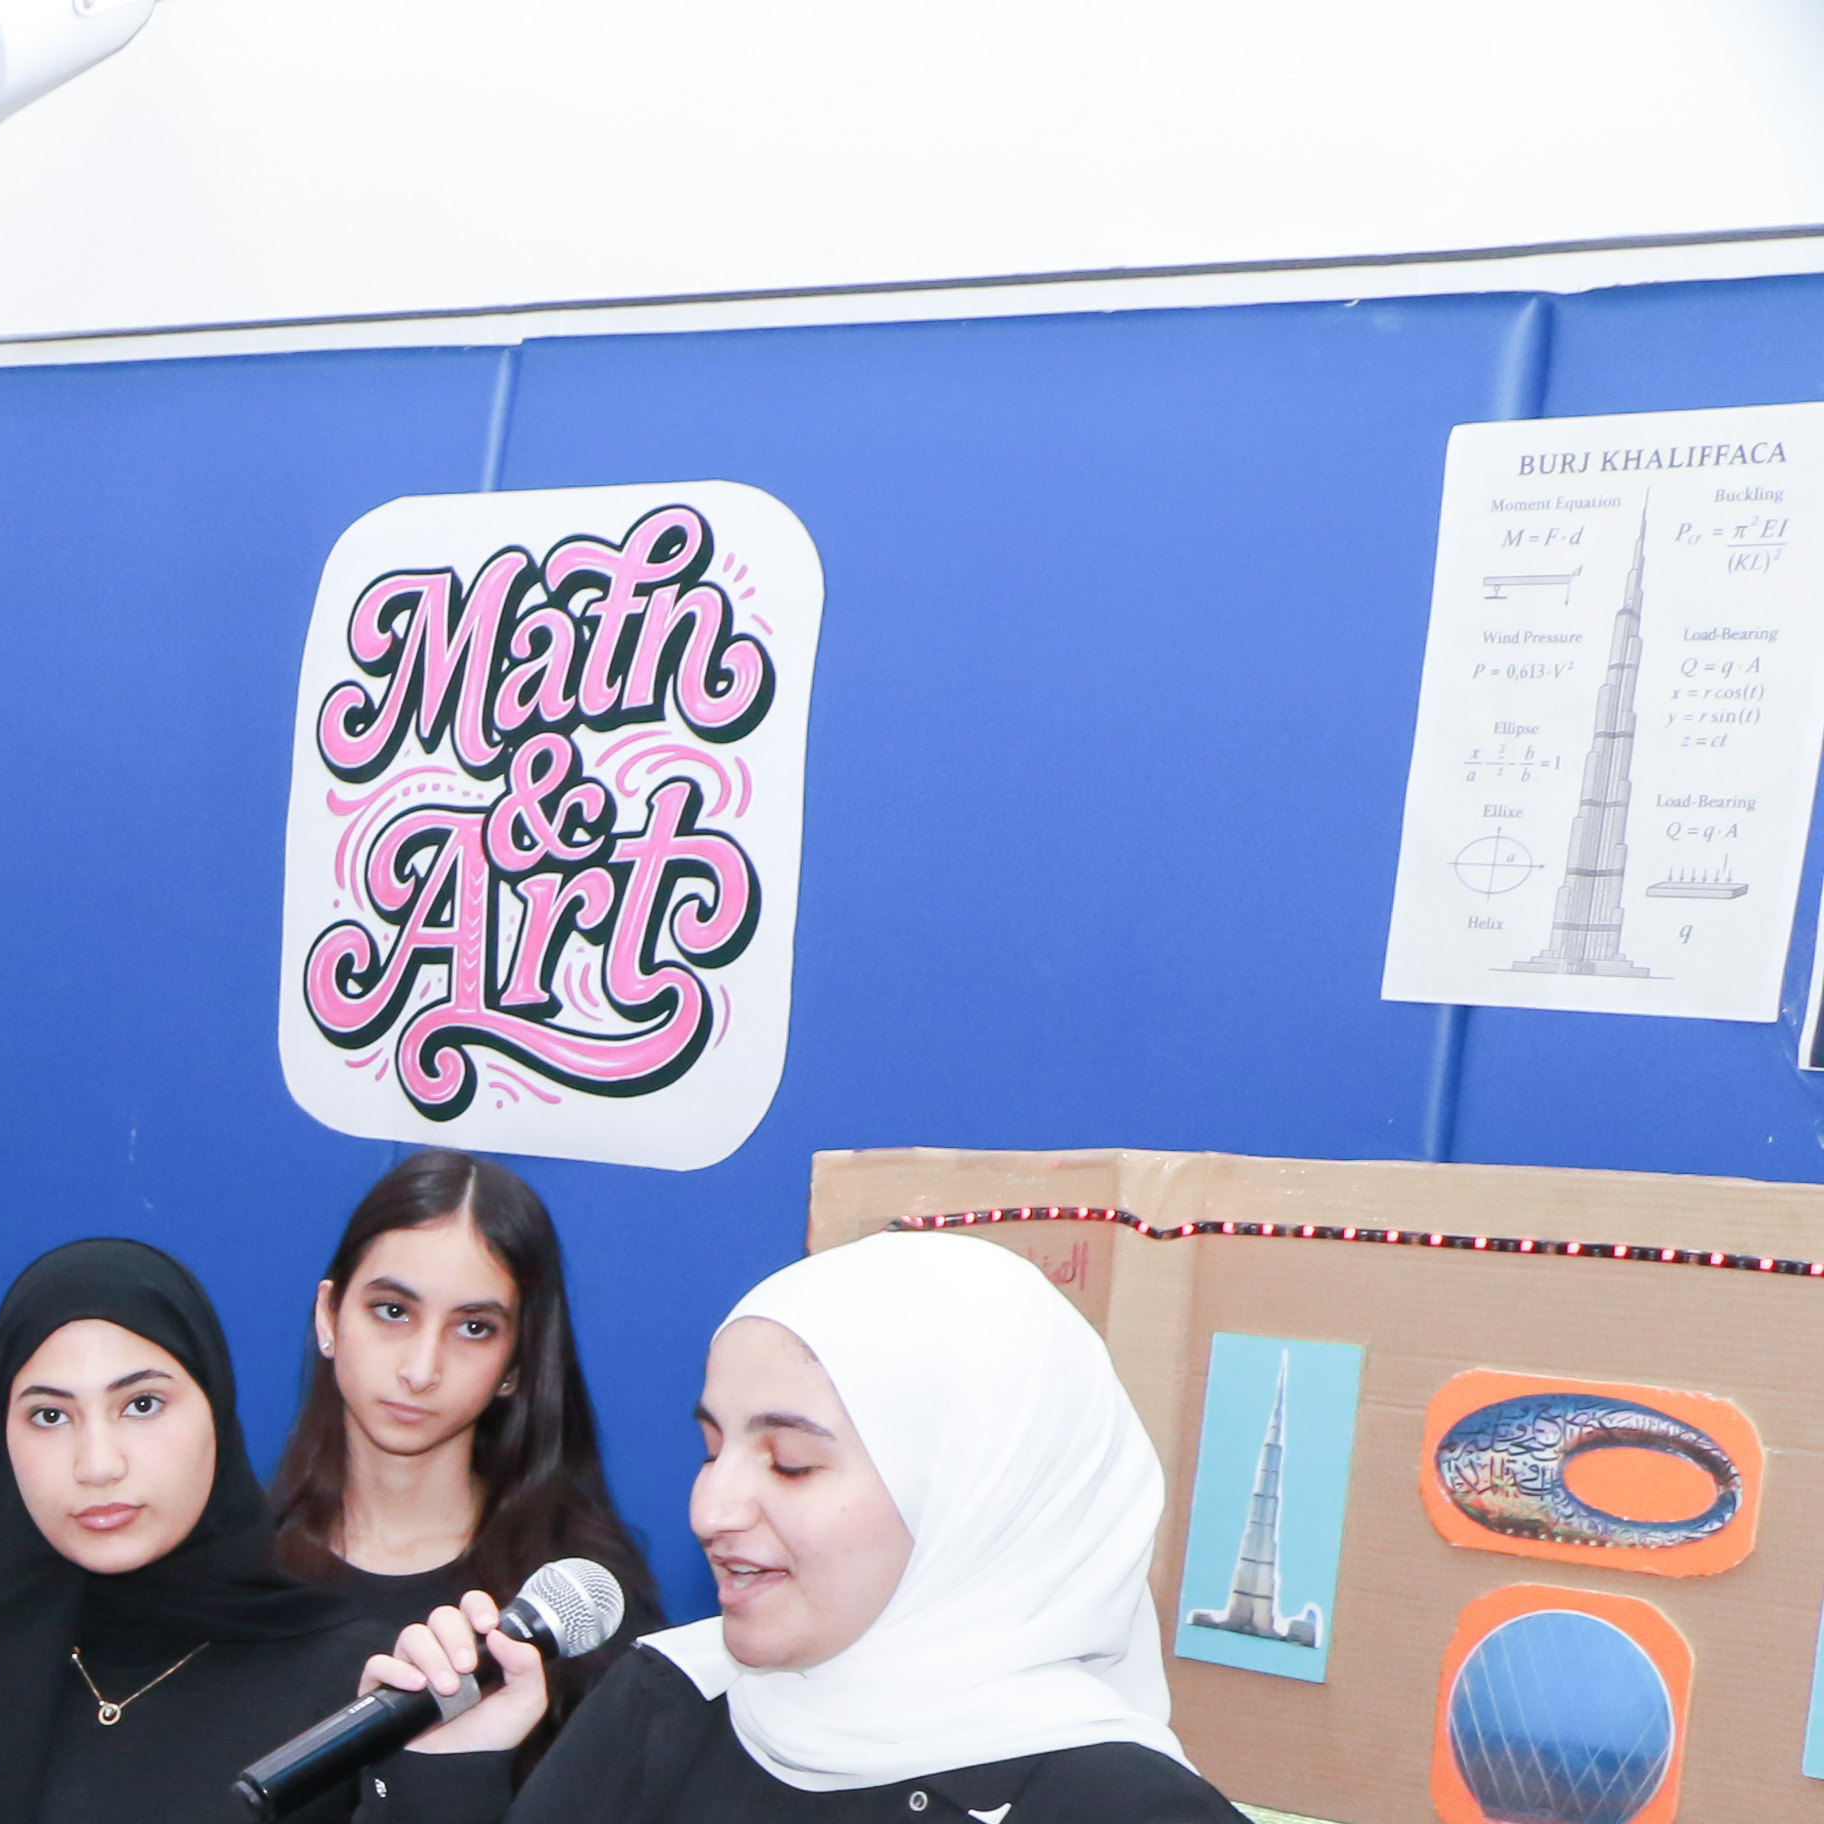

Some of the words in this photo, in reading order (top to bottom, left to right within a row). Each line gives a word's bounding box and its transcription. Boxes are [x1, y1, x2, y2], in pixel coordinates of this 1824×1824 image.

[1518, 450, 1589, 477] BURJ
[1600, 441, 1789, 473] KHALIFFACA
[1490, 497, 1551, 513] Moment
[1555, 494, 1622, 511] Equation
[1715, 487, 1785, 504] Buckling
[317, 504, 775, 783] Math
[1483, 630, 1520, 644] Wind
[1523, 630, 1583, 645] Pressure
[1682, 627, 1779, 643] Load-Bearing
[1493, 722, 1539, 736] Ellipse
[1656, 794, 1757, 812] Load-Bearing
[1468, 917, 1504, 931] Helix
[304, 777, 761, 1122] Art
